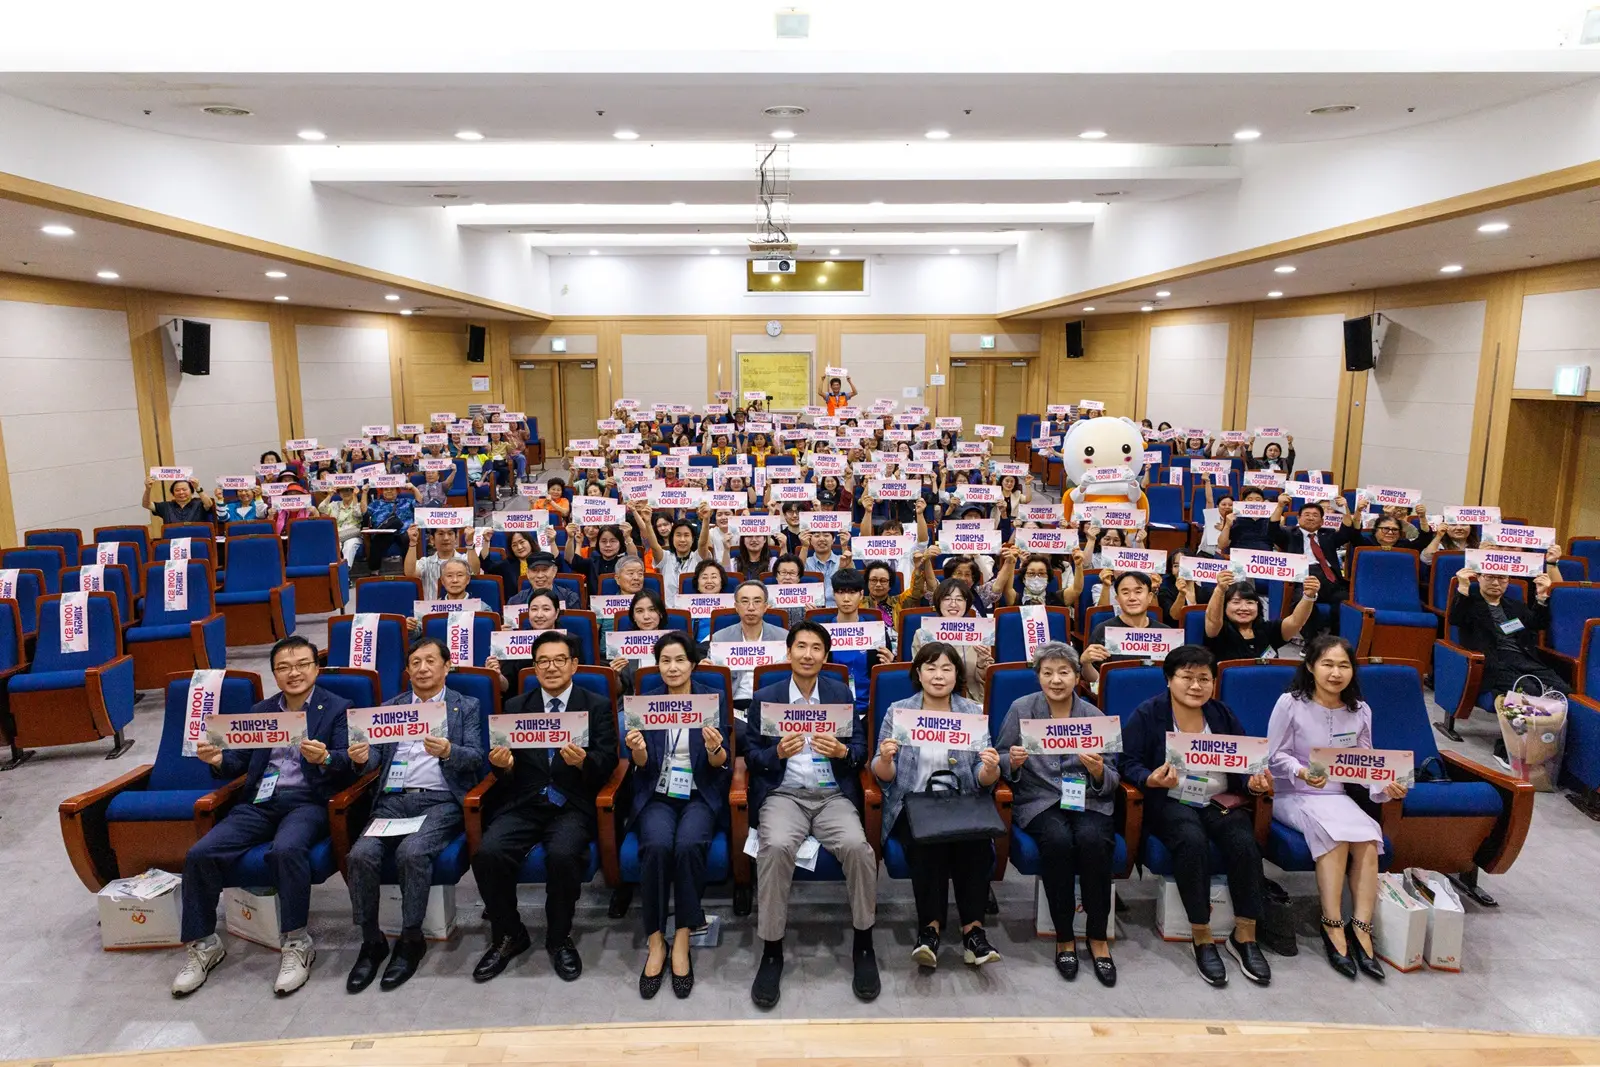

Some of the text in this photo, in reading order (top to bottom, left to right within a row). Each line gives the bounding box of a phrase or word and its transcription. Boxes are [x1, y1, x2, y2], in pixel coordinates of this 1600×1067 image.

[661, 490, 687, 498] 치매안녕
[1380, 488, 1407, 498] 치매안녕
[1376, 495, 1411, 505] 100세 경기
[1105, 511, 1131, 520] 치매안녕
[1479, 515, 1492, 523] 경기
[526, 521, 539, 529] 경기
[1101, 518, 1136, 527] 100세 경기
[955, 533, 984, 542] 치매안녕
[1031, 532, 1061, 541] 치매안녕
[1500, 527, 1535, 538] 치매안녕
[867, 539, 897, 548] 치매안녕
[1027, 540, 1067, 549] 100세 경기
[1496, 534, 1541, 546] 100세 경기
[864, 547, 903, 556] 100세 경기
[951, 542, 990, 551] 100세 경기
[1118, 550, 1149, 562] 치매안녕
[1250, 554, 1287, 568] 치매안녕
[1485, 553, 1522, 565] 치매안녕
[1113, 559, 1155, 570] 100세 경기
[1246, 563, 1295, 578] 100세 경기
[1480, 561, 1529, 574] 100세 경기
[1192, 570, 1217, 579] 100세
[778, 587, 807, 596] 치매안녕
[775, 595, 814, 604] 100세 경기
[431, 604, 462, 612] 치매안녕
[64, 603, 74, 642] 100세 경기
[74, 606, 83, 635] 치매안녕
[940, 621, 975, 632] 치매안녕
[830, 627, 864, 637] 치매안녕
[935, 631, 982, 642] 100세 경기
[1027, 618, 1036, 643] 100세
[354, 626, 364, 652] 100세
[451, 625, 459, 650] 100세
[510, 636, 539, 645] 치매안
[832, 636, 872, 647] 00세 경기
[1125, 631, 1162, 643] 치매안녕
[362, 630, 373, 663] 치매안녕
[460, 628, 469, 660] 치매안녕
[1120, 641, 1170, 653] 100세 경기
[621, 646, 647, 655] 100세
[730, 646, 766, 656] 치매안녕
[726, 655, 773, 666] 100세 경기
[648, 700, 693, 712] 치매안녕
[188, 687, 204, 741] 100세 경기
[372, 710, 419, 726] 치매안녕
[643, 712, 702, 725] 100세 경기
[783, 709, 827, 722] 치매안녕
[230, 719, 279, 732] 치매안녕
[515, 718, 561, 731] 치매안녕
[778, 721, 836, 734] 100세 경기
[916, 715, 962, 732] 치매안녕
[367, 722, 430, 739] 100세 경기
[510, 730, 571, 743] 100세 경기
[1045, 724, 1093, 737] 치매안녕
[226, 731, 290, 744] 100세 경기
[910, 728, 971, 746] 100세 경기
[1041, 736, 1104, 749] 100세 경기
[1190, 738, 1237, 755] 치매안녕
[1184, 751, 1247, 769] 100세 경기
[1334, 752, 1386, 769] 치매안녕
[1328, 764, 1395, 782] 100세 경기
